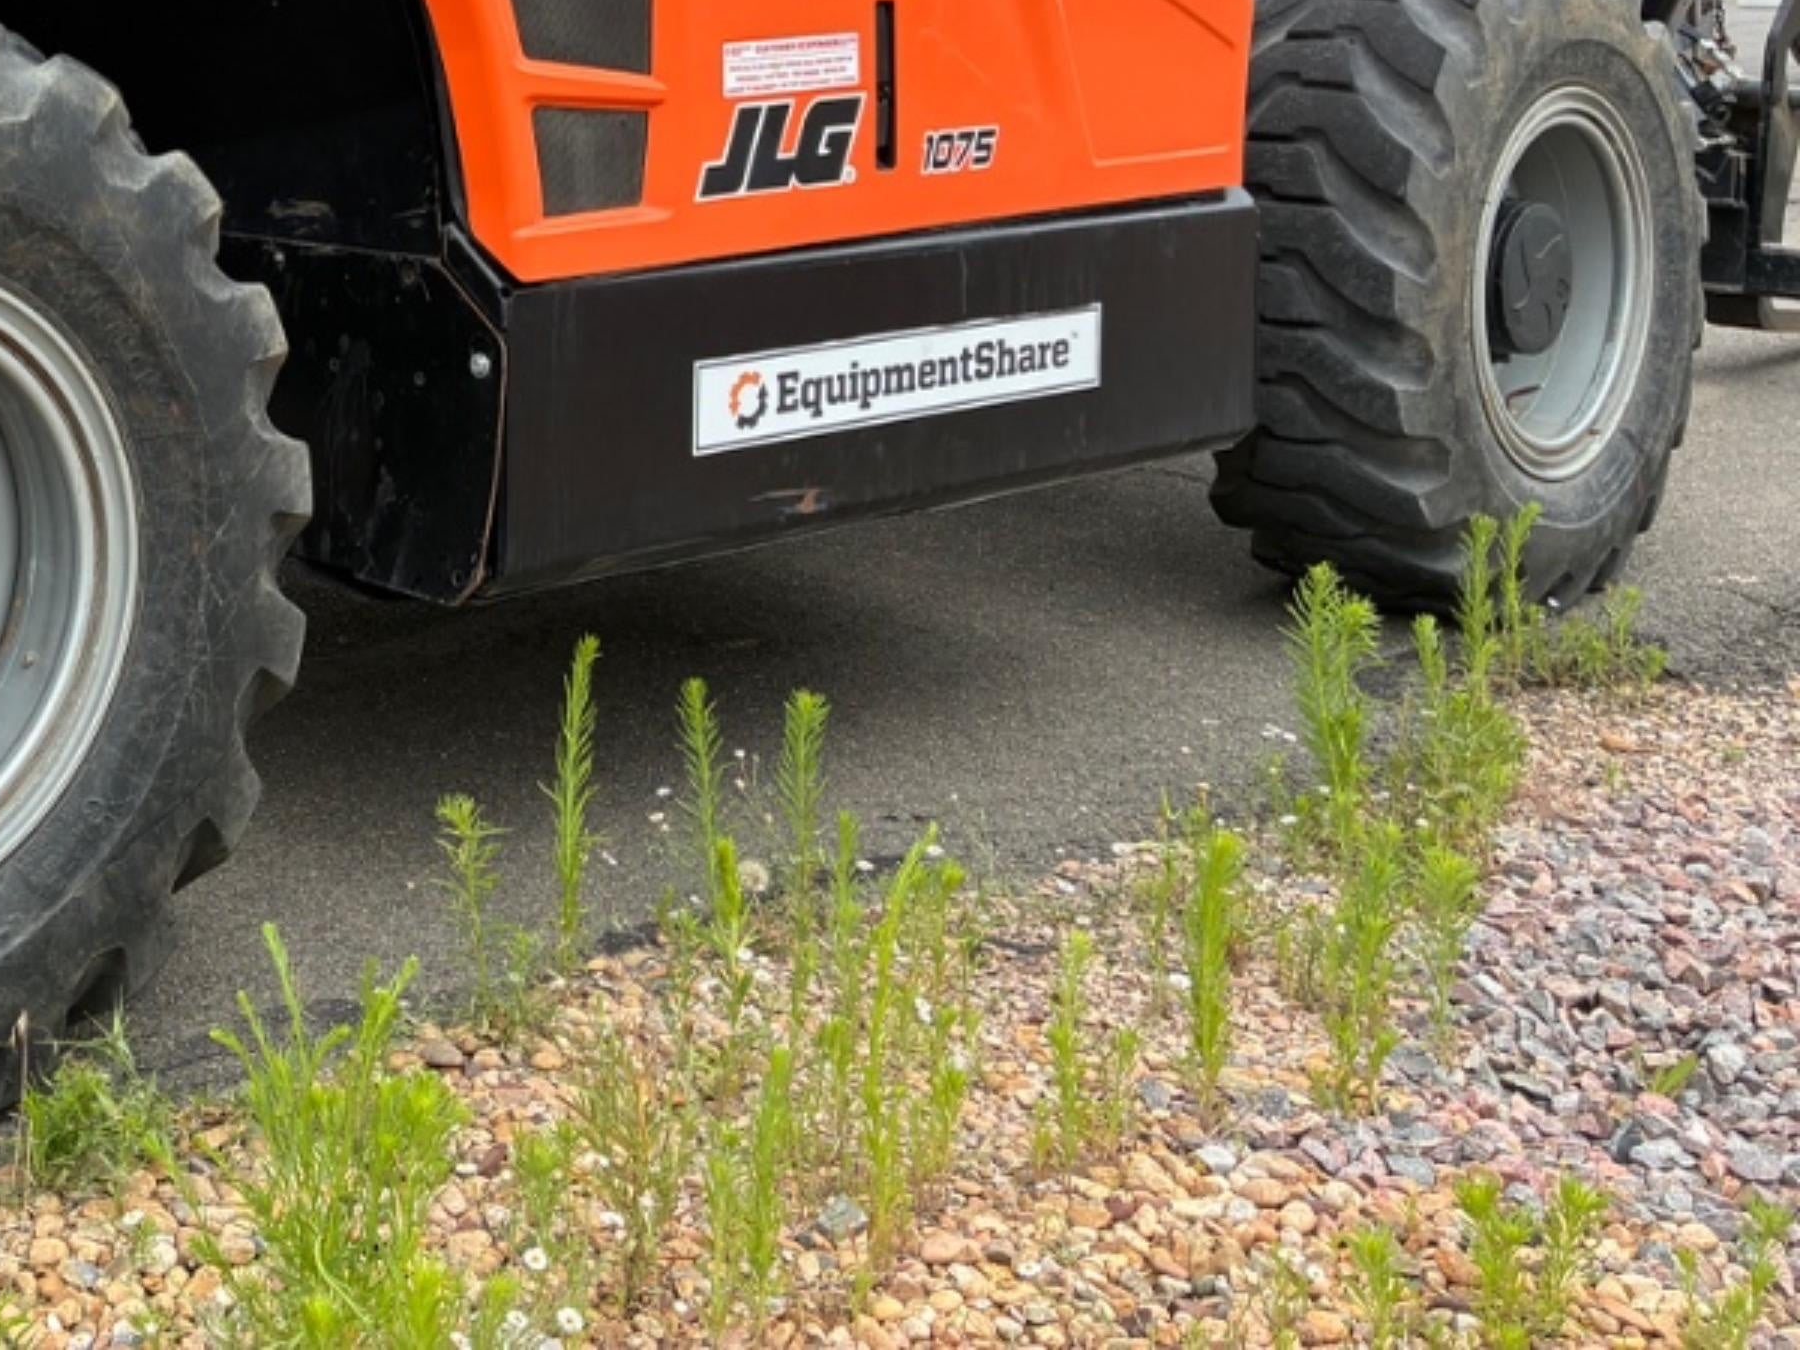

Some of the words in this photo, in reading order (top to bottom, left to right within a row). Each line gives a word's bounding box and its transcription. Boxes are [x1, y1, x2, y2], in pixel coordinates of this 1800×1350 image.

[697, 95, 864, 199] JLG
[922, 127, 998, 173] 1075
[775, 336, 1070, 418] EquipmentShare
